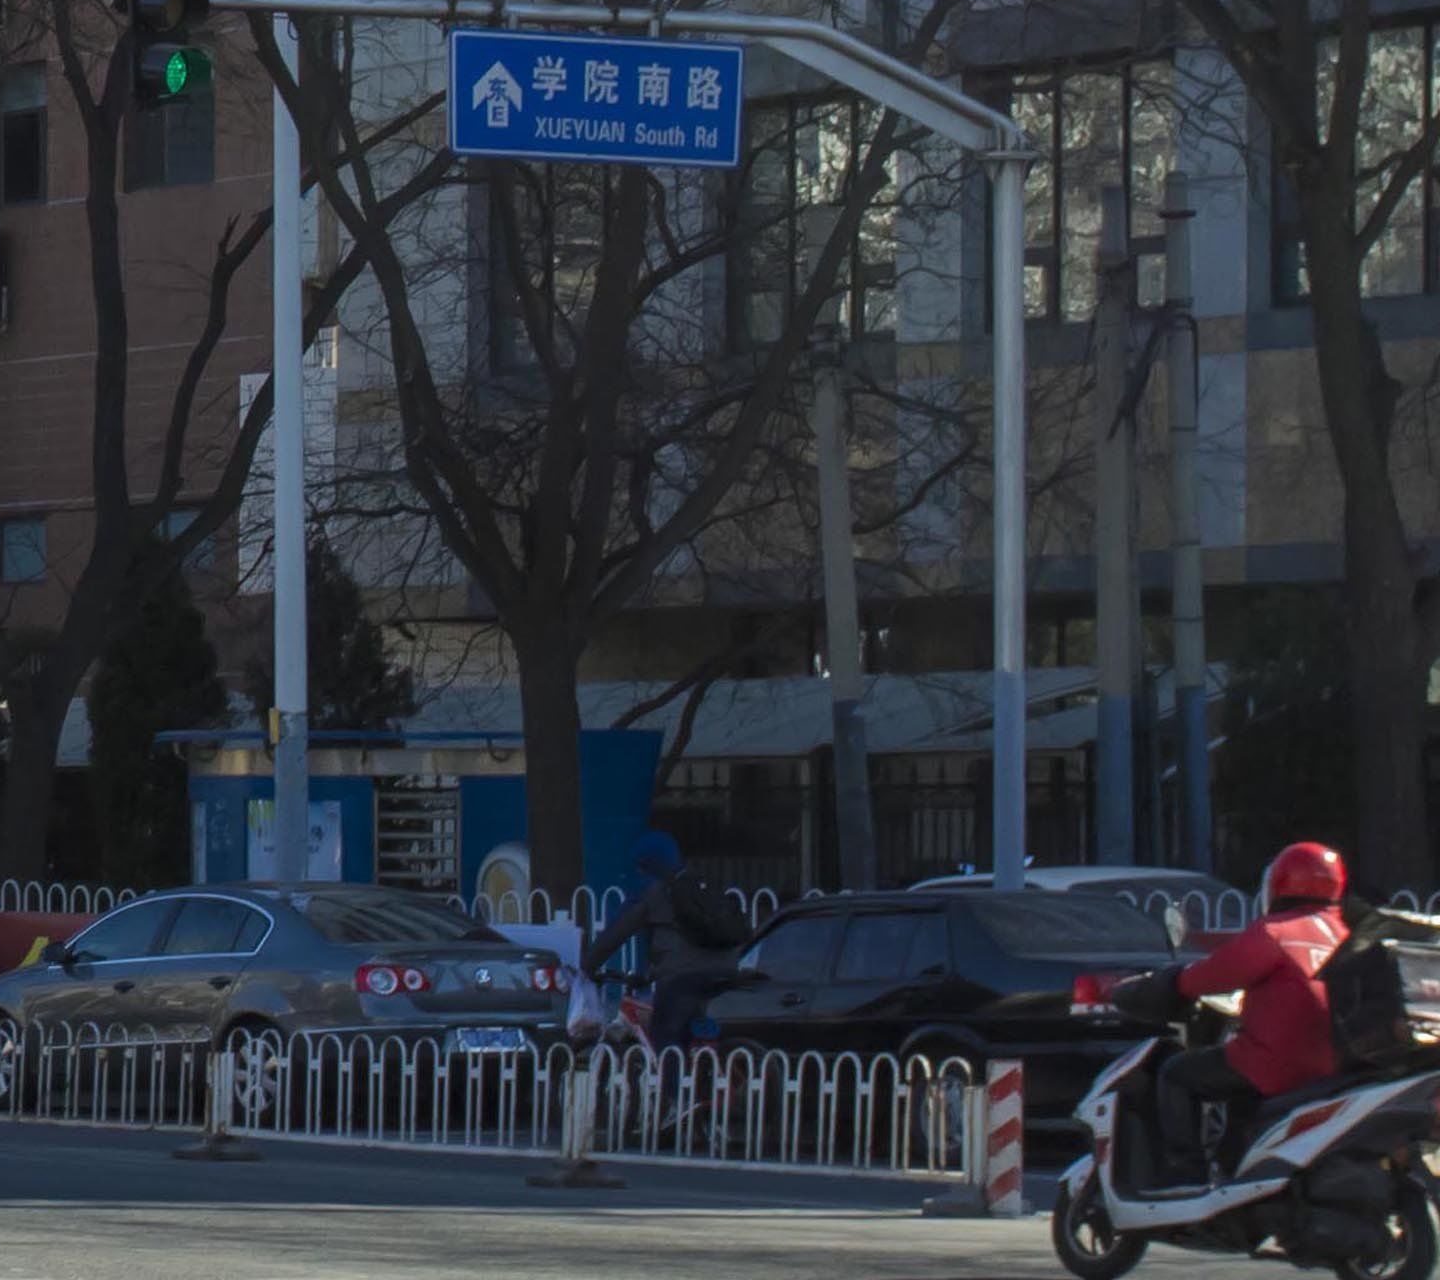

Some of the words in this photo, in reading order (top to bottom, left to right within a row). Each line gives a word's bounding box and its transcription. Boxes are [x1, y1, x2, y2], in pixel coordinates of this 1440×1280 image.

[488, 78, 508, 101] 东
[532, 56, 722, 110] 学院南路
[492, 105, 505, 122] E
[535, 116, 625, 143] XUEYUAN
[635, 123, 685, 146] South
[695, 126, 718, 148] Rd
